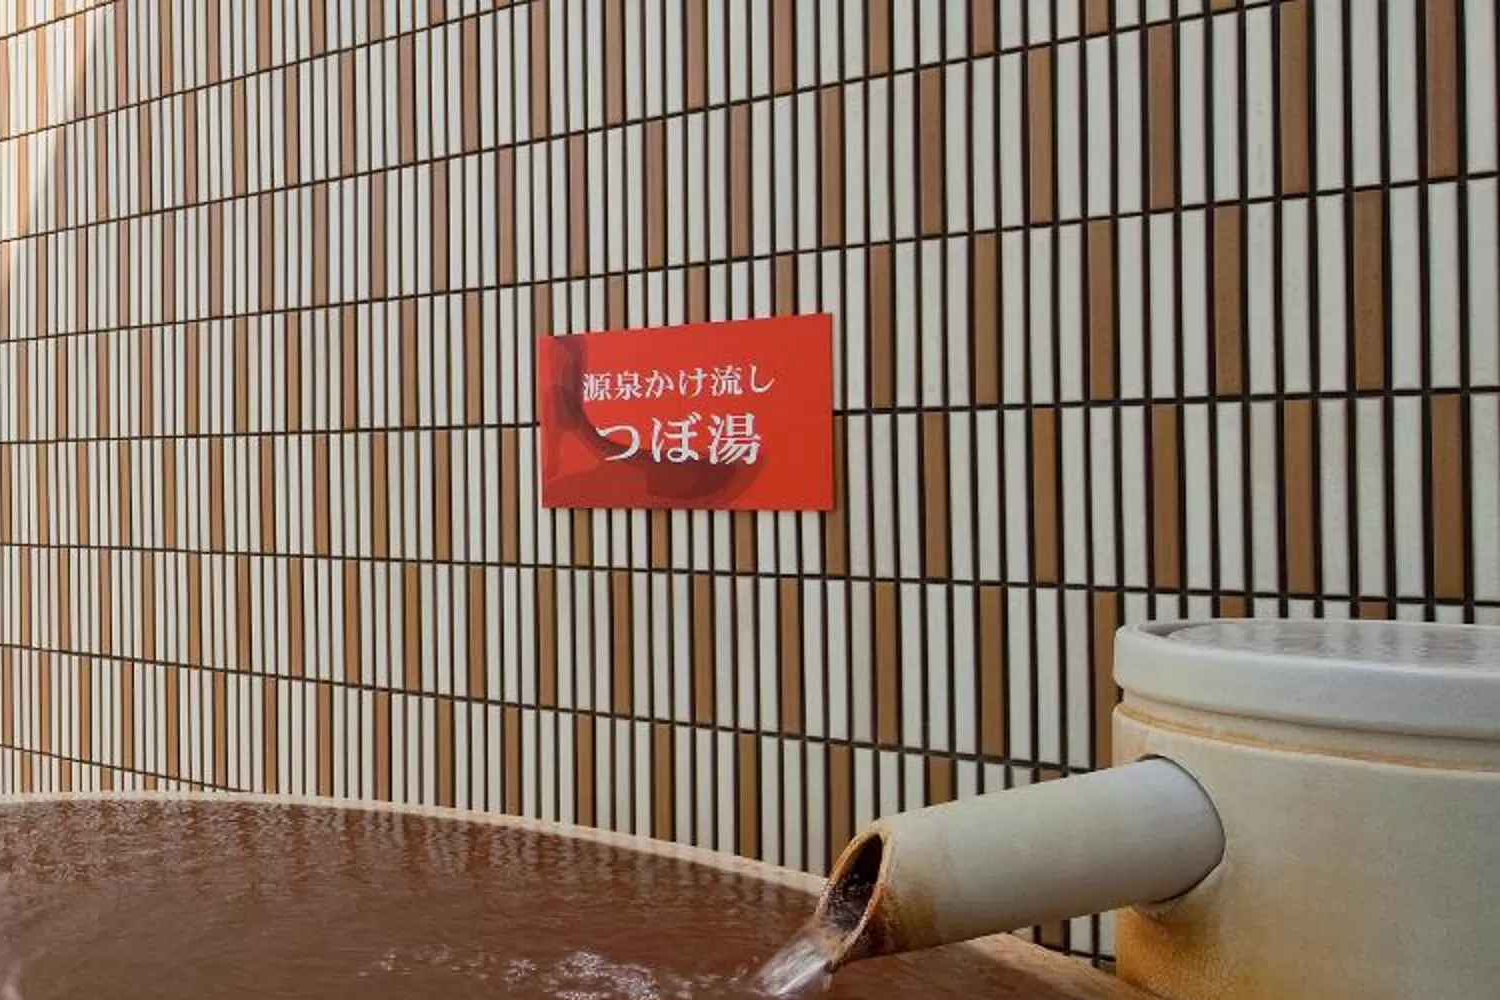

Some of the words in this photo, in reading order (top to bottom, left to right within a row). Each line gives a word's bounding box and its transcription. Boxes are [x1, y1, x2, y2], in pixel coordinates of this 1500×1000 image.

[582, 364, 775, 401] 源泉かけ流し
[594, 411, 762, 465] つぼ湯
